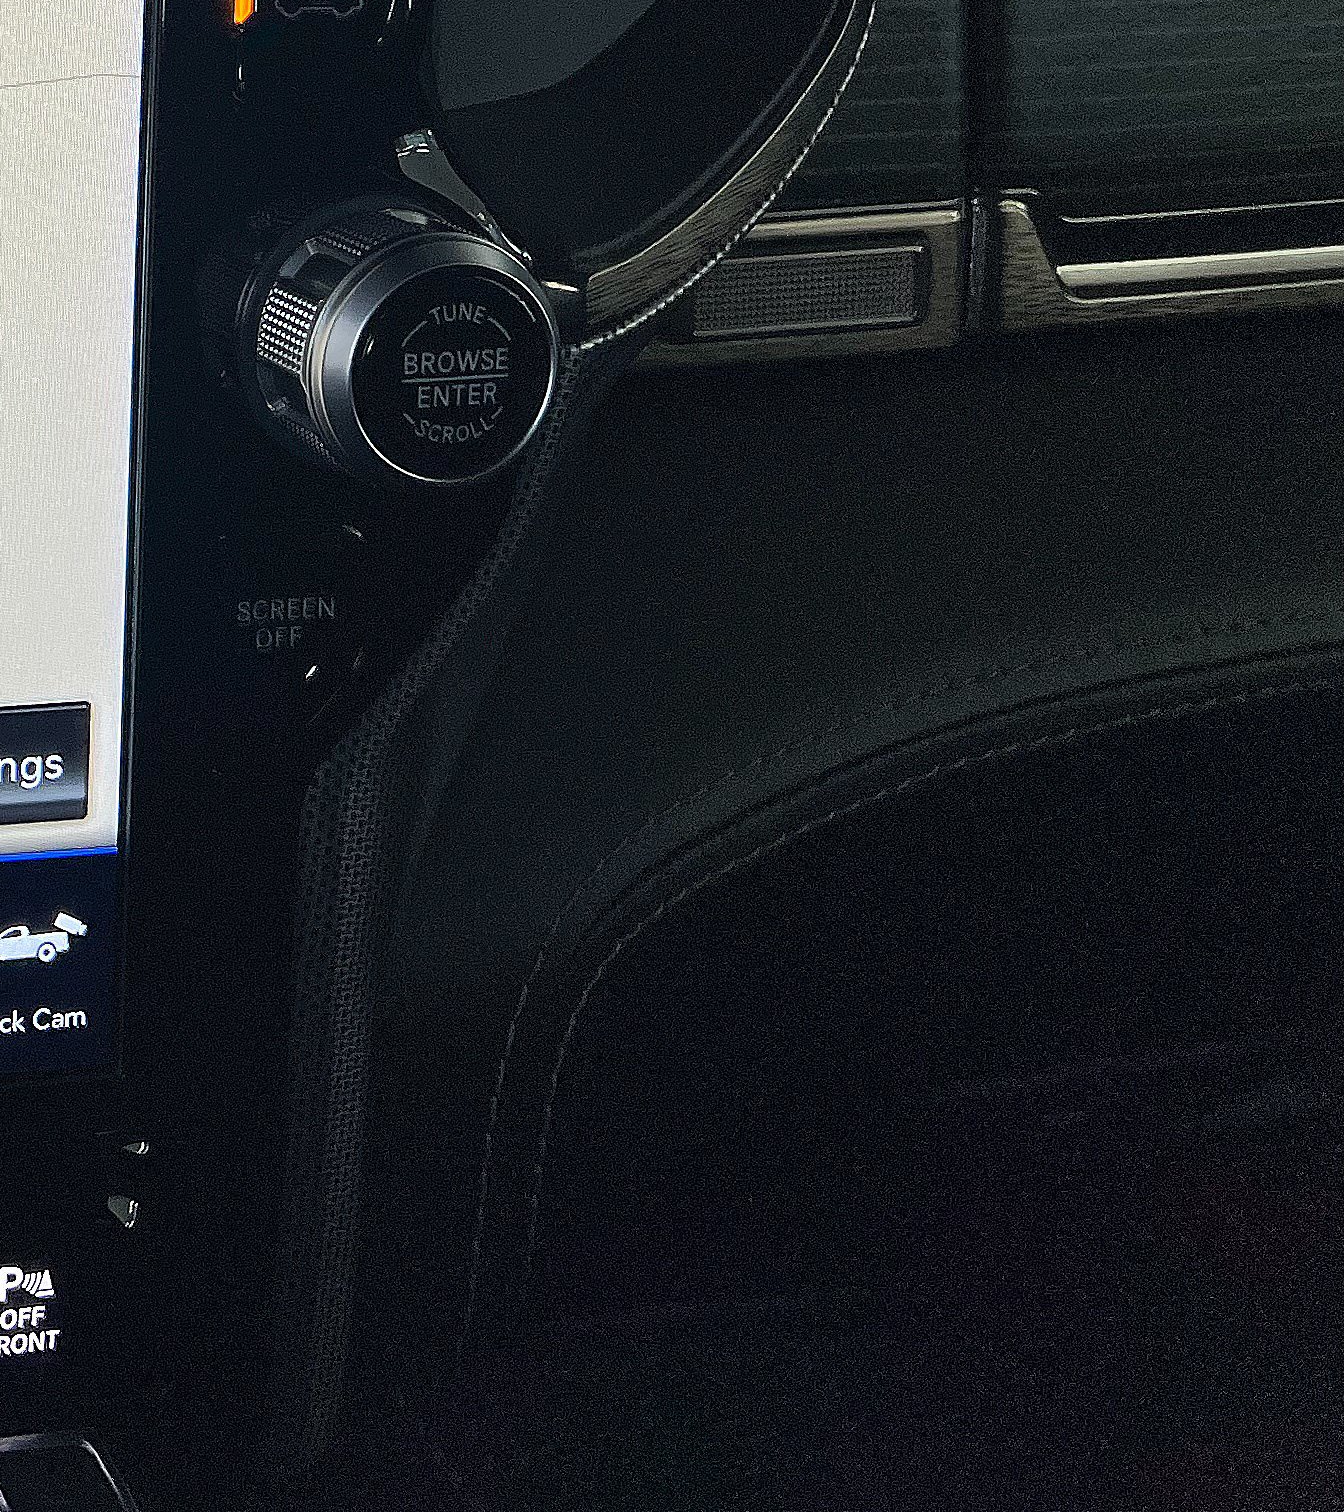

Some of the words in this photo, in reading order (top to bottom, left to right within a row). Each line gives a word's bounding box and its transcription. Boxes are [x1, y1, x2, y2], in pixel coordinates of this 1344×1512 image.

[429, 302, 487, 326] TUNE
[403, 346, 509, 376] BROWSE
[417, 383, 497, 409] ENTER
[413, 416, 494, 445] SCROLL
[238, 596, 335, 622] SCREEN
[256, 625, 302, 650] OFF
[32, 1006, 87, 1031] Cam
[0, 1305, 45, 1331] OFF
